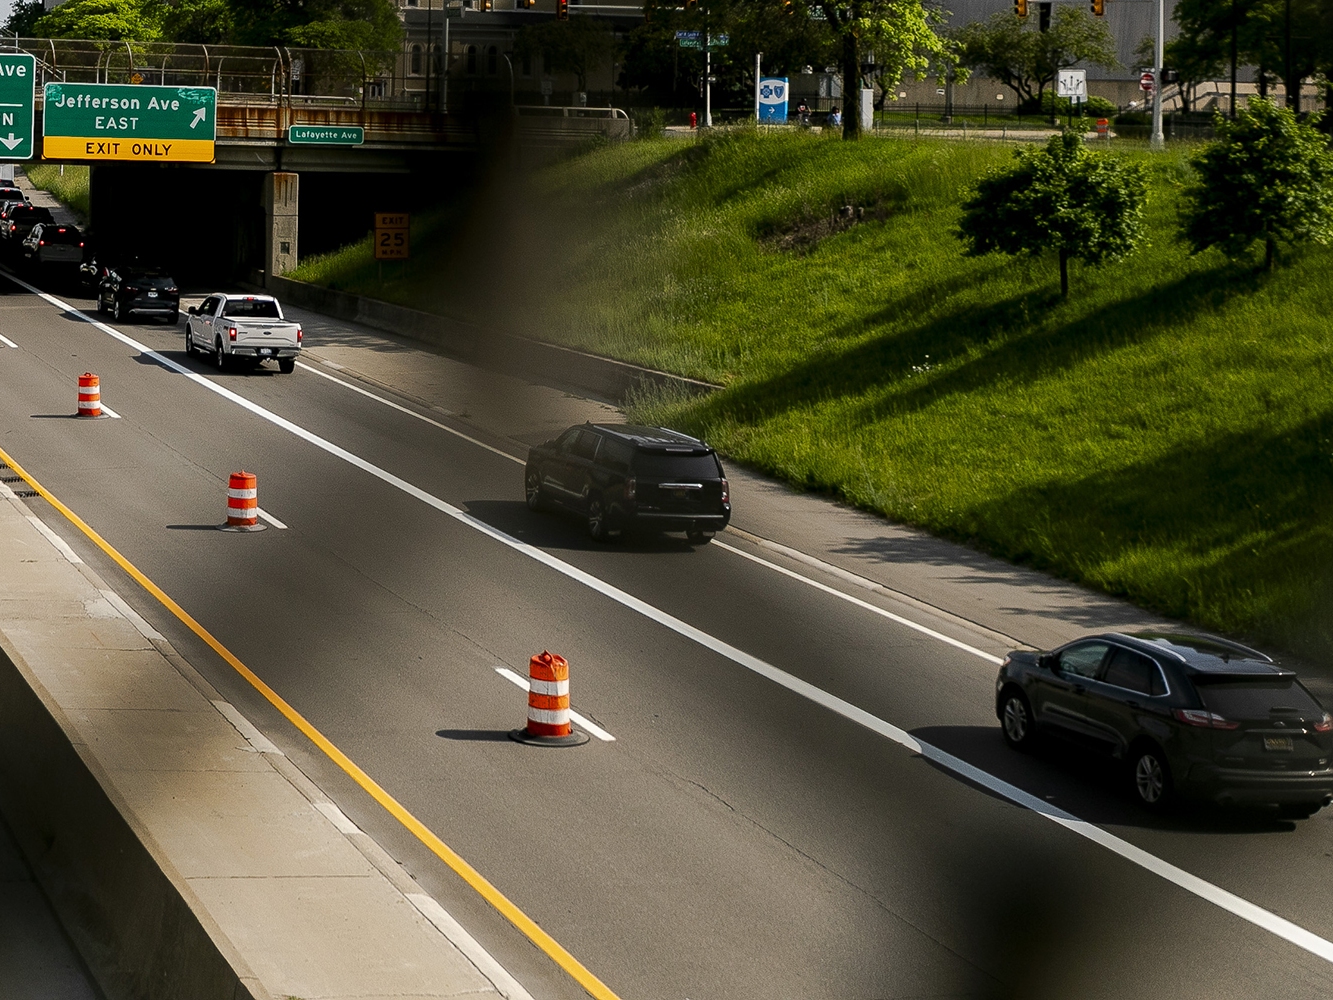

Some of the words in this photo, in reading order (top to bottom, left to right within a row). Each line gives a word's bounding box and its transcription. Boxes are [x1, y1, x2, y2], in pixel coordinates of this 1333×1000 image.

[55, 93, 140, 110] Jefferson
[147, 97, 180, 111] Ave
[95, 116, 139, 130] EAST
[295, 130, 338, 140] Lafayette
[341, 131, 357, 139] Ave
[86, 142, 121, 155] EXIT
[132, 143, 173, 156] ONLY
[381, 233, 404, 246] 25
